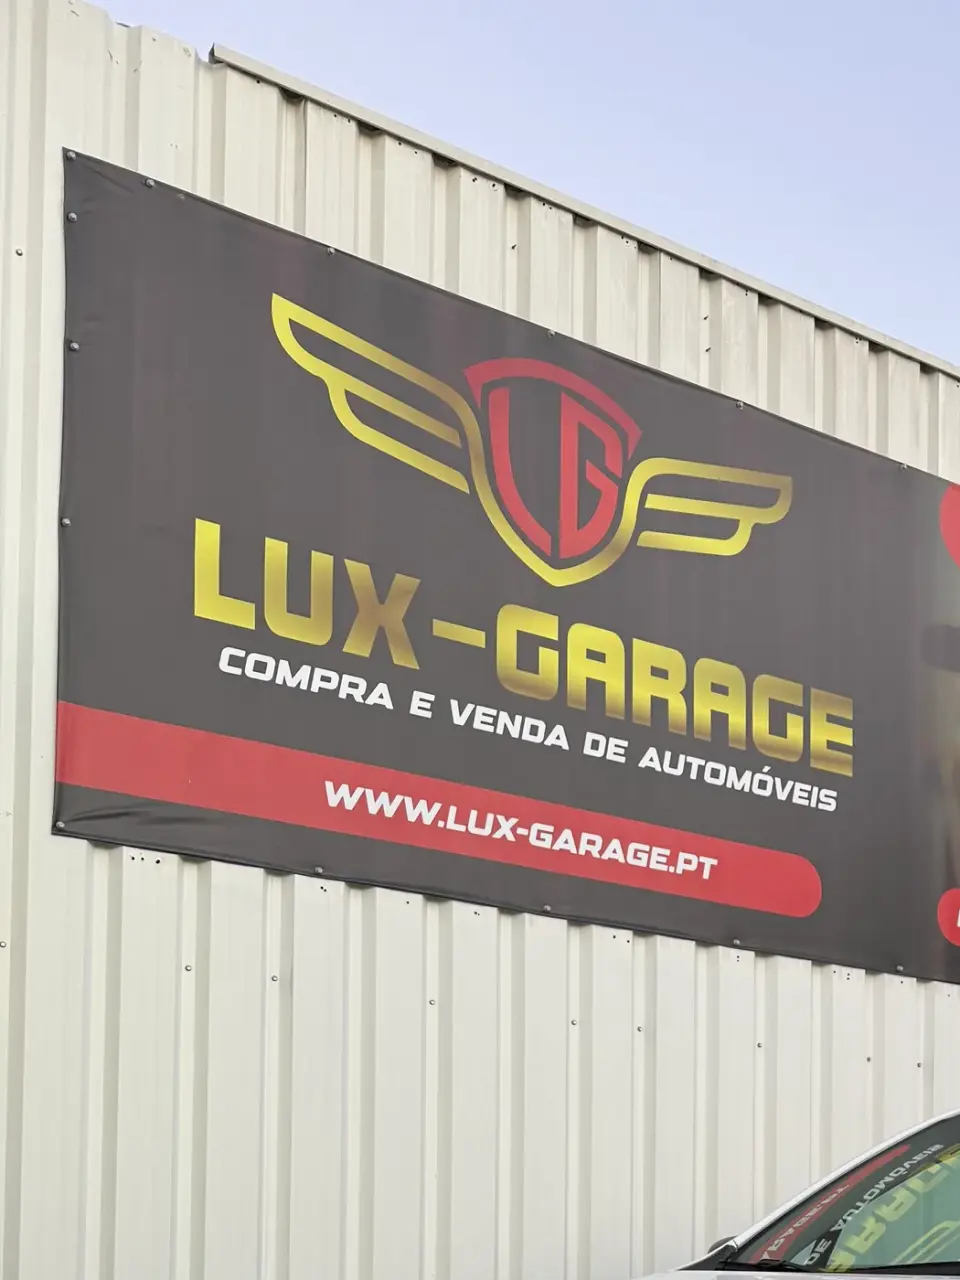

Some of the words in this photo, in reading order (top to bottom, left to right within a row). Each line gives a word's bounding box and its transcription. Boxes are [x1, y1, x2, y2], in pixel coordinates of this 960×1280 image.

[194, 517, 854, 777] LUX-GARAGE
[218, 646, 394, 711] COMPRA
[410, 692, 435, 719] E
[449, 700, 571, 750] VENDA
[583, 732, 628, 764] DE
[638, 745, 838, 812] AUTOMÓVEIS
[324, 780, 718, 882] WWW.LUX-GARAGE.PT
